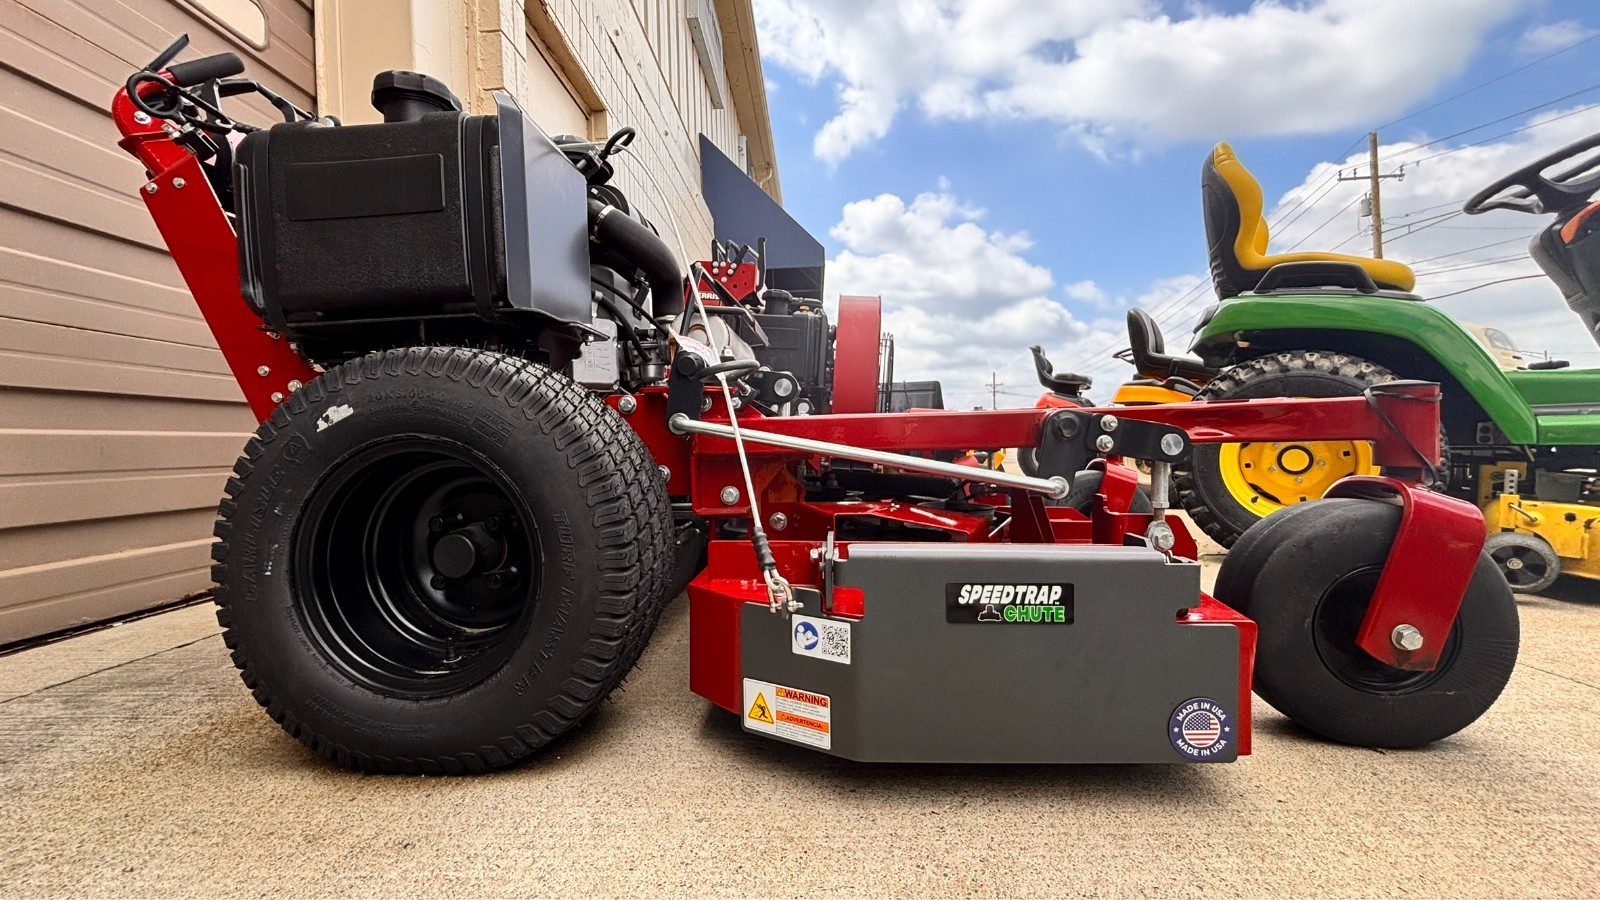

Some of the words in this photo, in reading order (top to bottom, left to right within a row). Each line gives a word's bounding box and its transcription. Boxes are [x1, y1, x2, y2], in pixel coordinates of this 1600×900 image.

[698, 292, 720, 300] ERRIS
[553, 508, 576, 581] TURF
[958, 584, 1062, 604] SPEEDTRAP
[1003, 605, 1065, 622] CHUTE
[784, 689, 827, 707] WARNING
[1176, 702, 1199, 721] MADE
[1200, 702, 1210, 710] IN
[1211, 705, 1227, 721] USA
[1176, 738, 1199, 756] MADE
[1200, 748, 1210, 756] IN
[1211, 739, 1227, 753] USA
